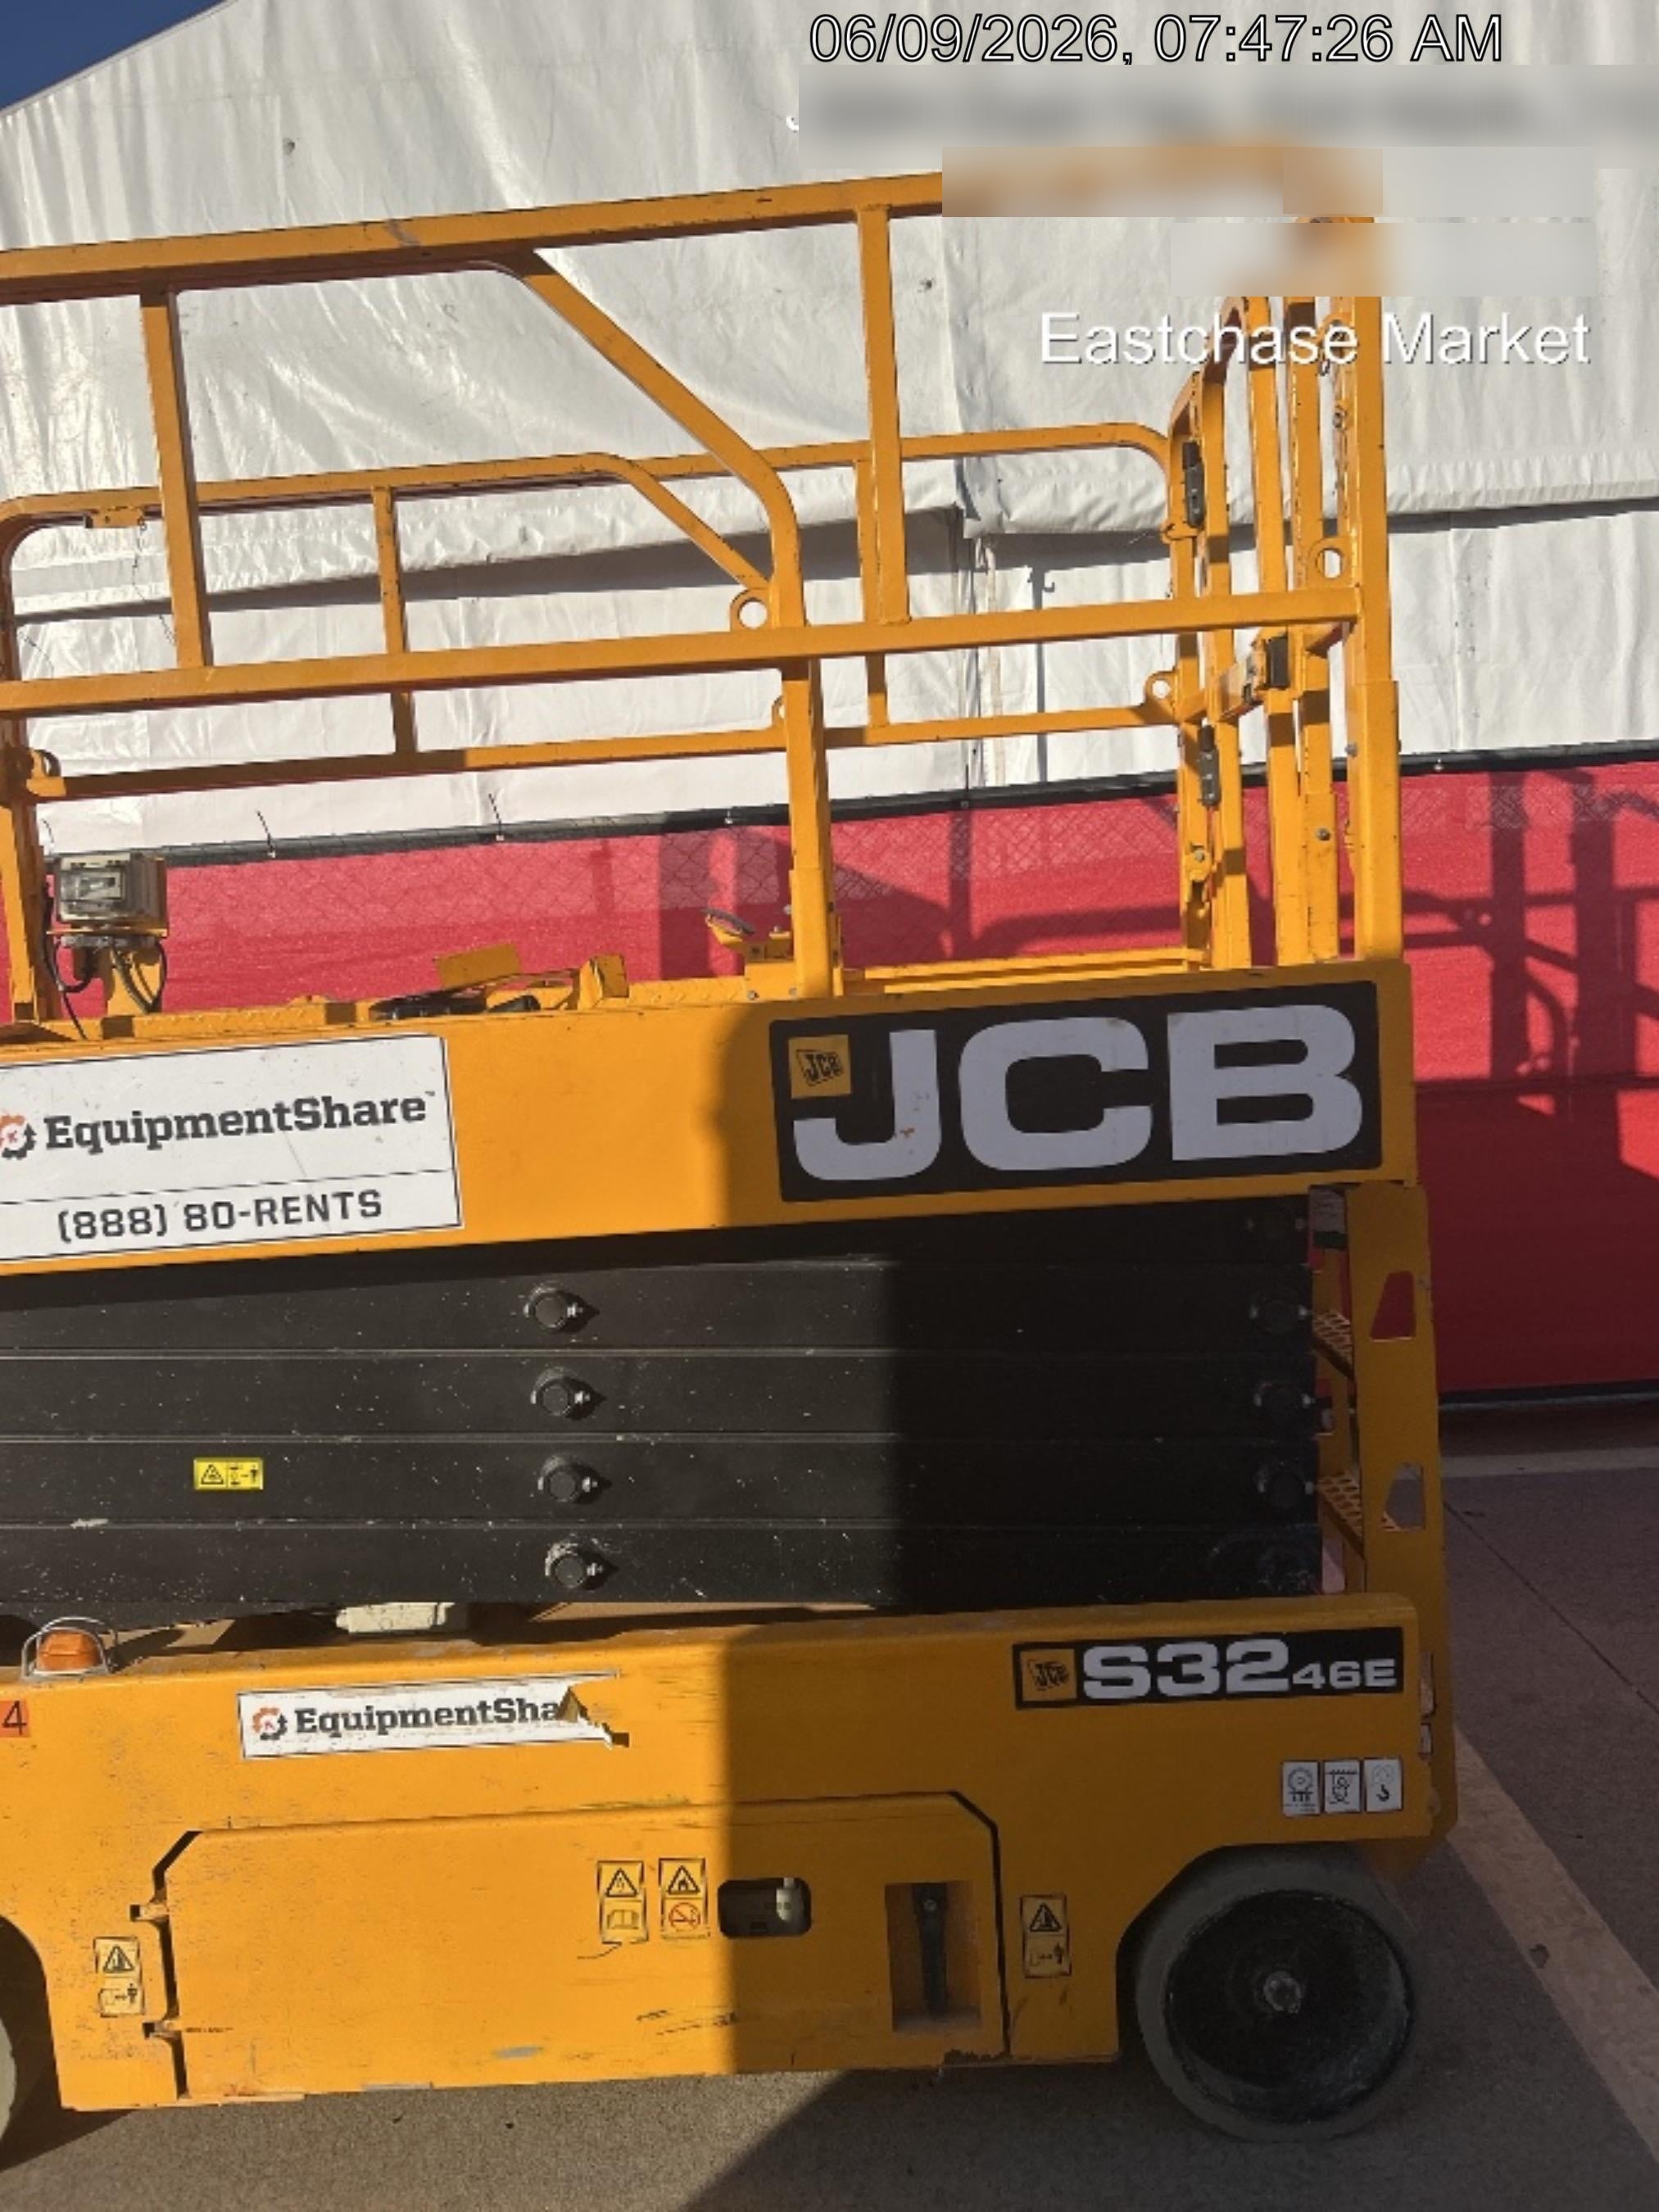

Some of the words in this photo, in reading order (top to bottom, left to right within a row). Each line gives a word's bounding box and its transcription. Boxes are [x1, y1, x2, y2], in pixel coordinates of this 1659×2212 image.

[792, 1004, 1362, 1181] JCB
[44, 1095, 427, 1154] EquipmentShare
[57, 1203, 167, 1244] (888)
[184, 1189, 382, 1231] 80-RENTS
[295, 1698, 560, 1735] EquipmentSha
